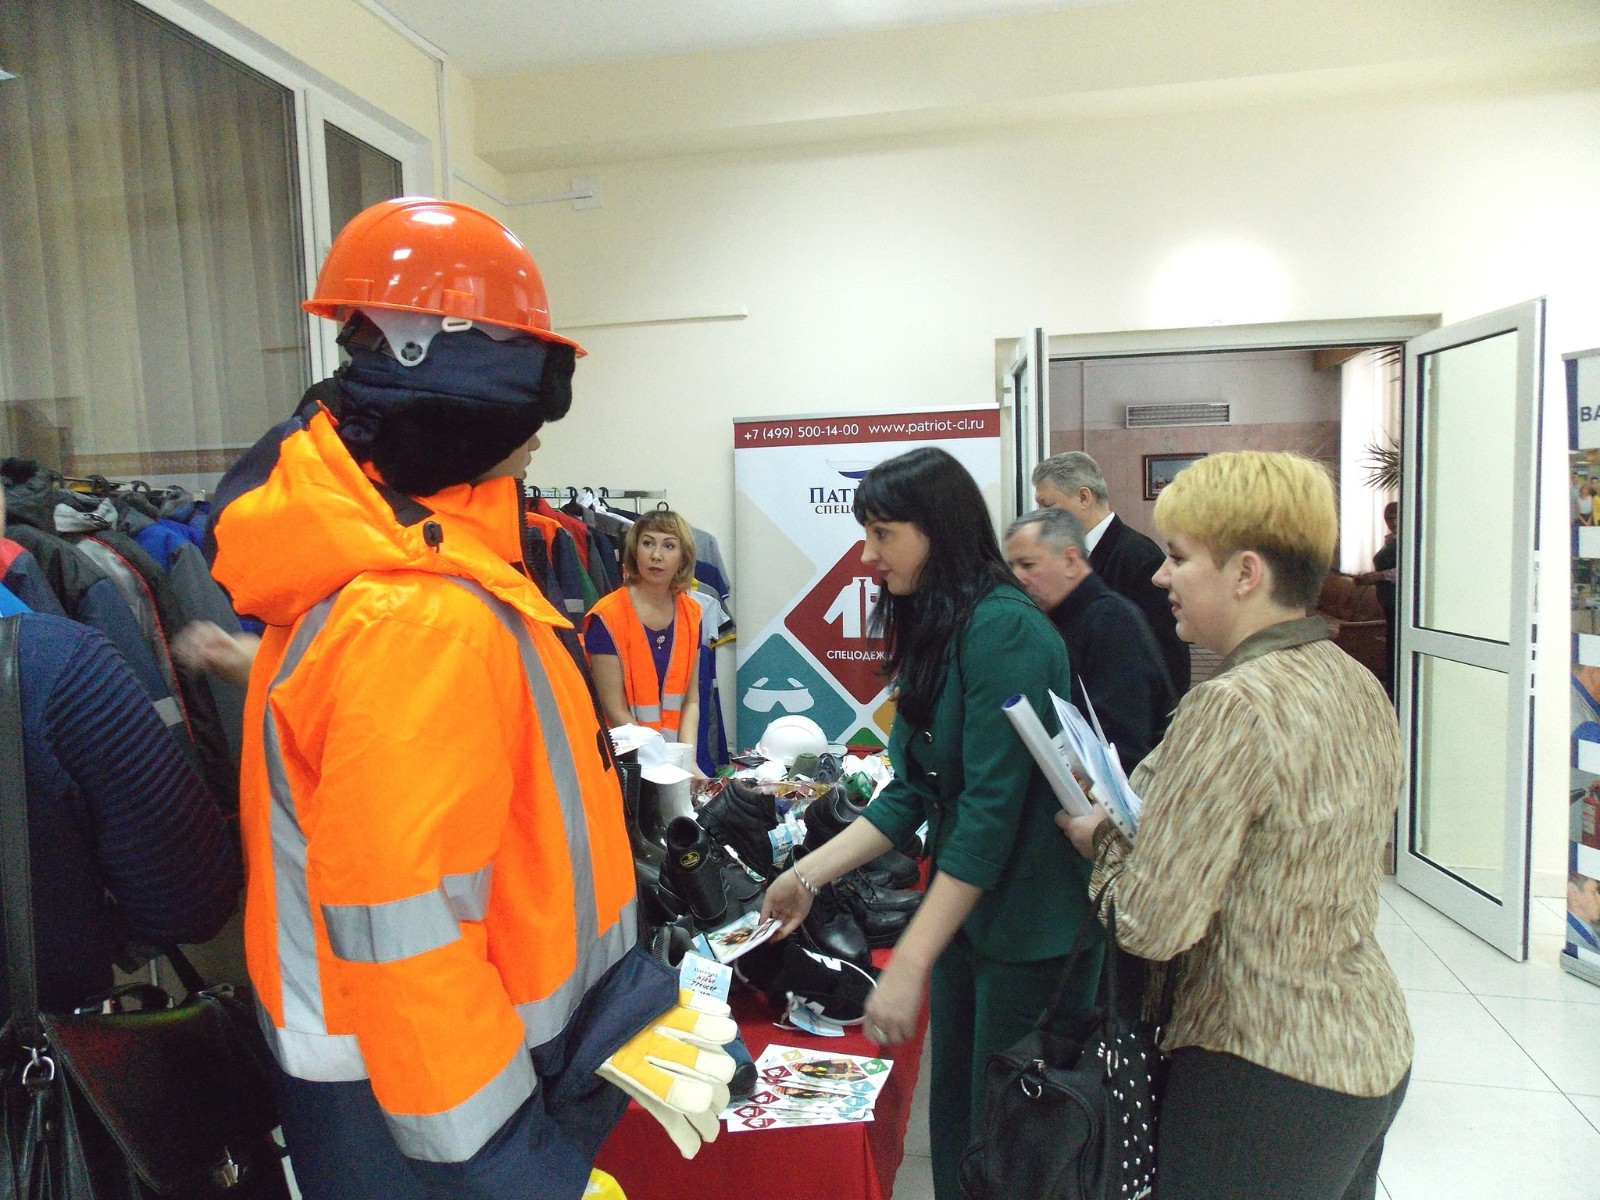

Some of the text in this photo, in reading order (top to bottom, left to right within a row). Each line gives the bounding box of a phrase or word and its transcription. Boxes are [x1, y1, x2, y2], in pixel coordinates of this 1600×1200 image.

[744, 418, 984, 440] +7 (499) 500-14-00 www.patriot-cl.ru
[809, 487, 858, 503] ПАТ
